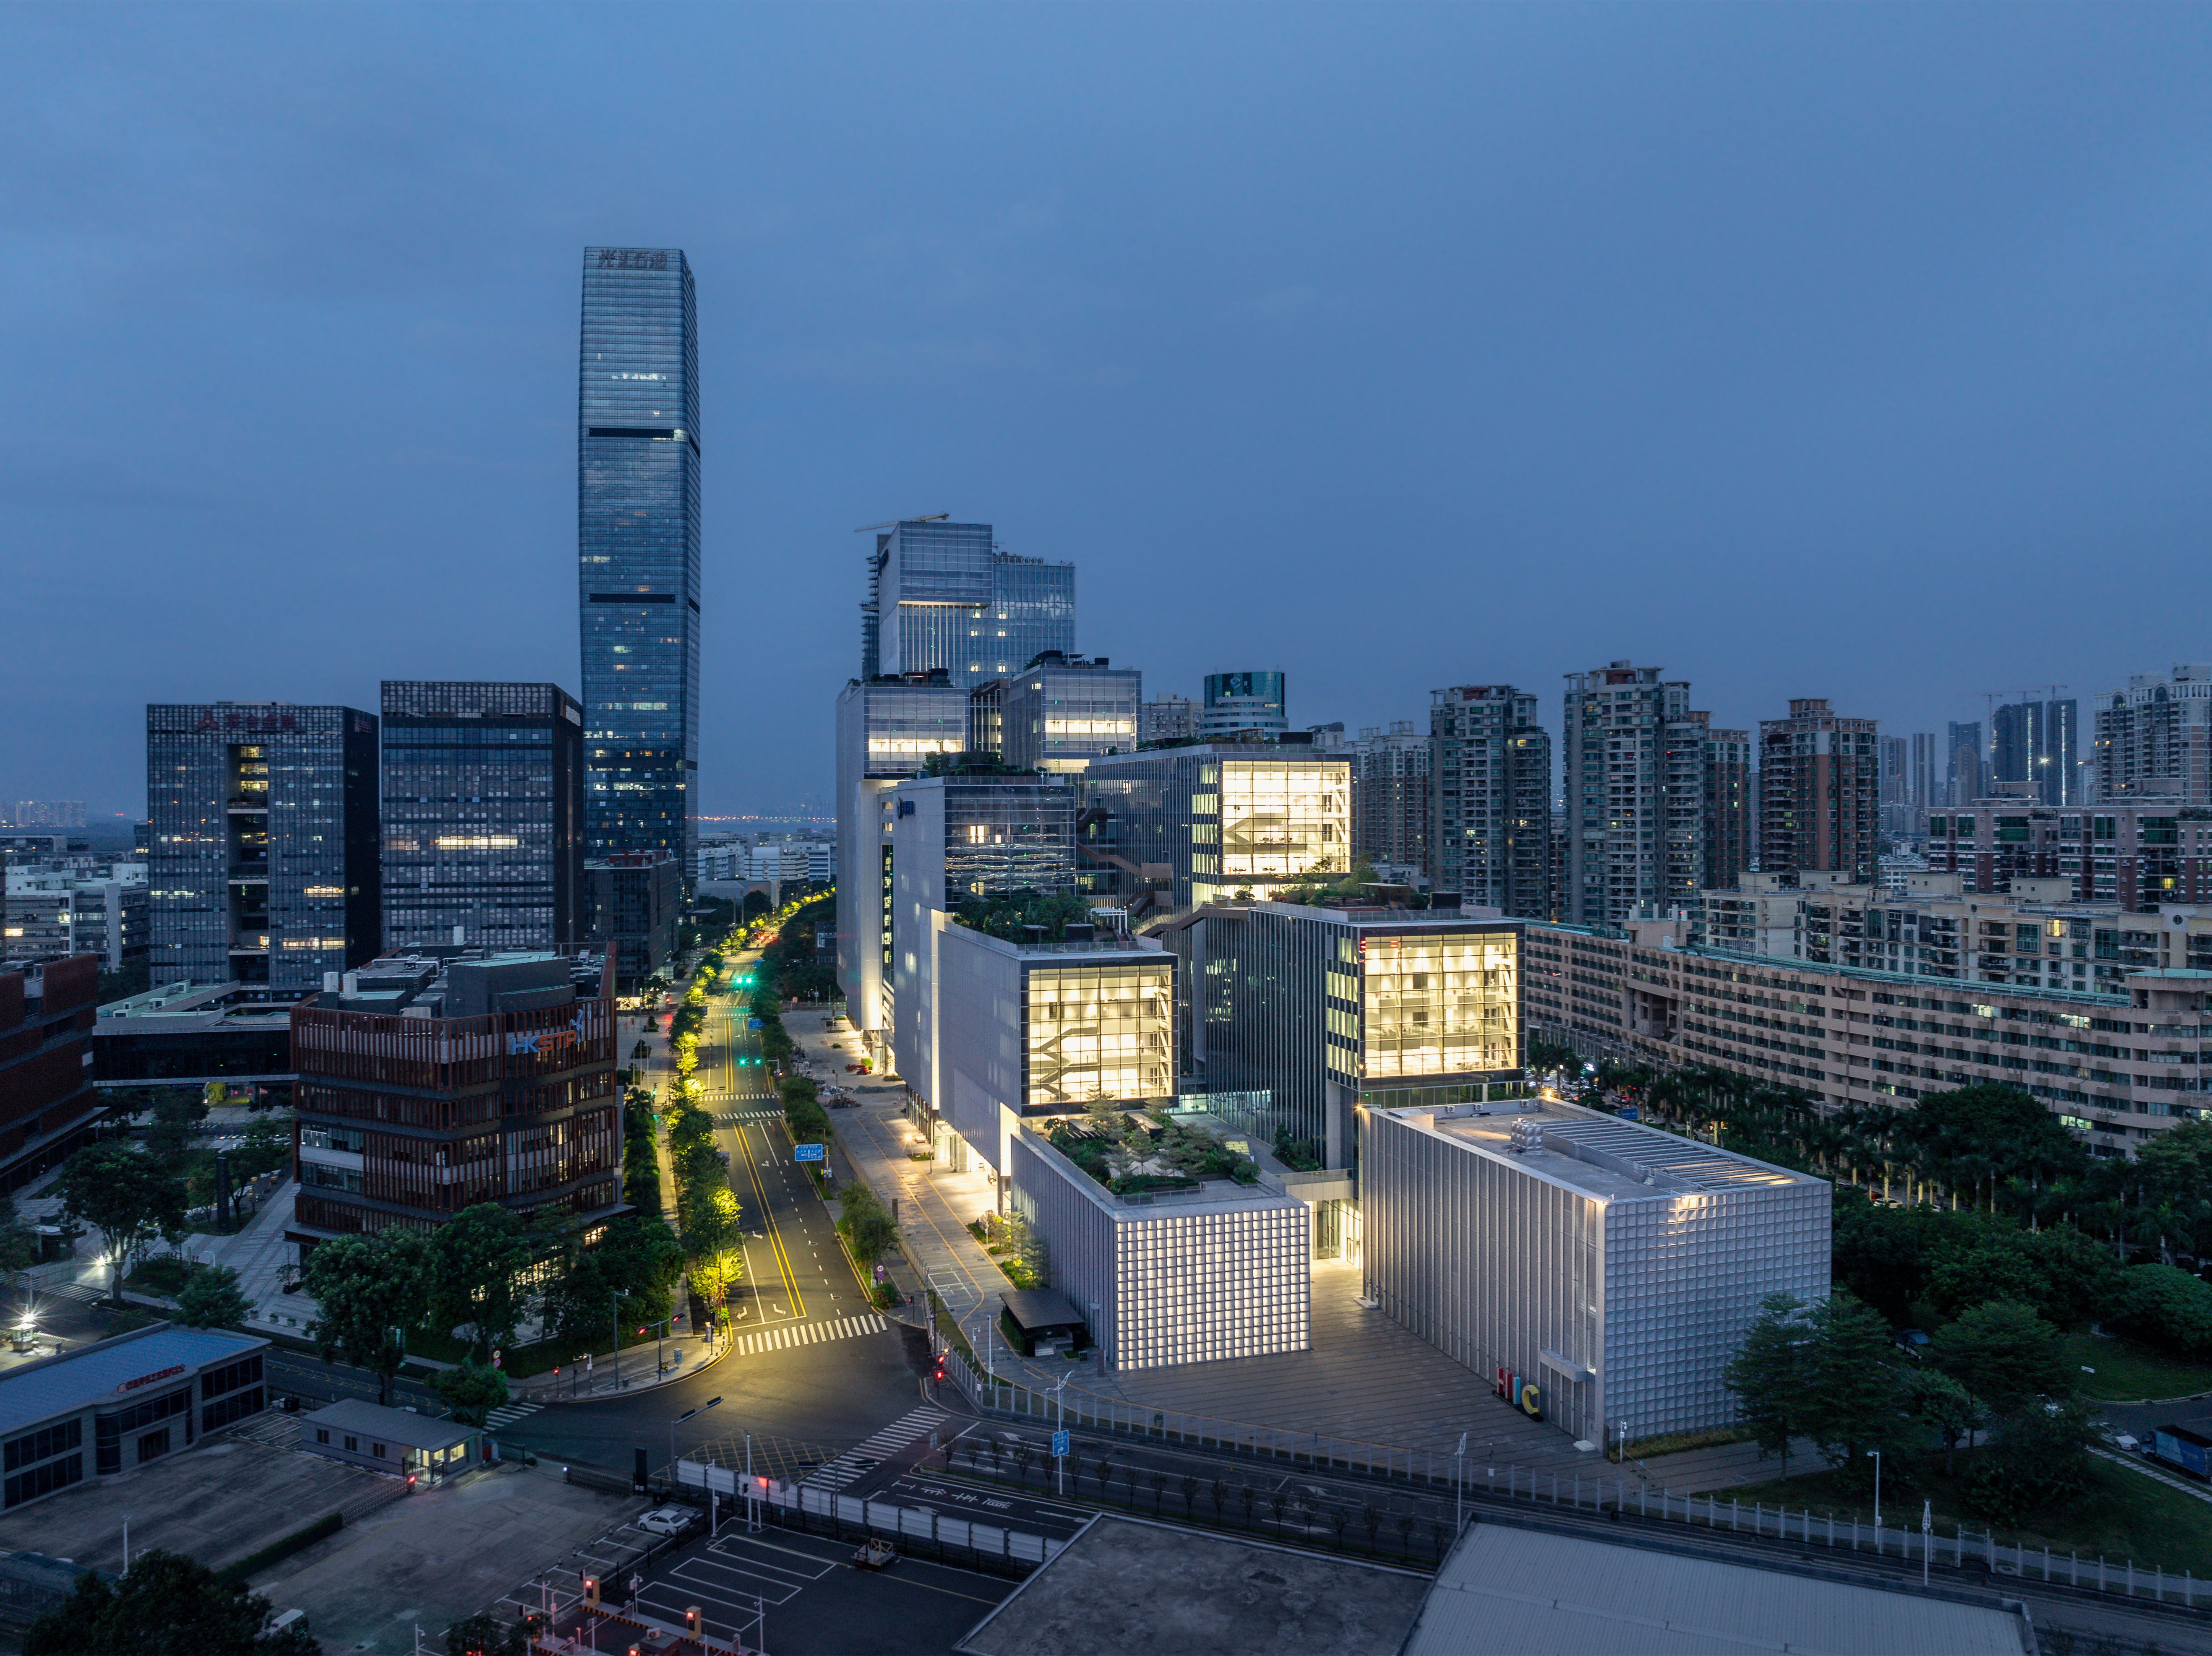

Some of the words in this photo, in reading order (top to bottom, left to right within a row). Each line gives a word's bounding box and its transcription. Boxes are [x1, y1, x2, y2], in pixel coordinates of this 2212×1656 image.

[598, 249, 668, 268] 光汇石油
[511, 1030, 576, 1055] HKSTP
[1496, 1367, 1539, 1414] HIC
